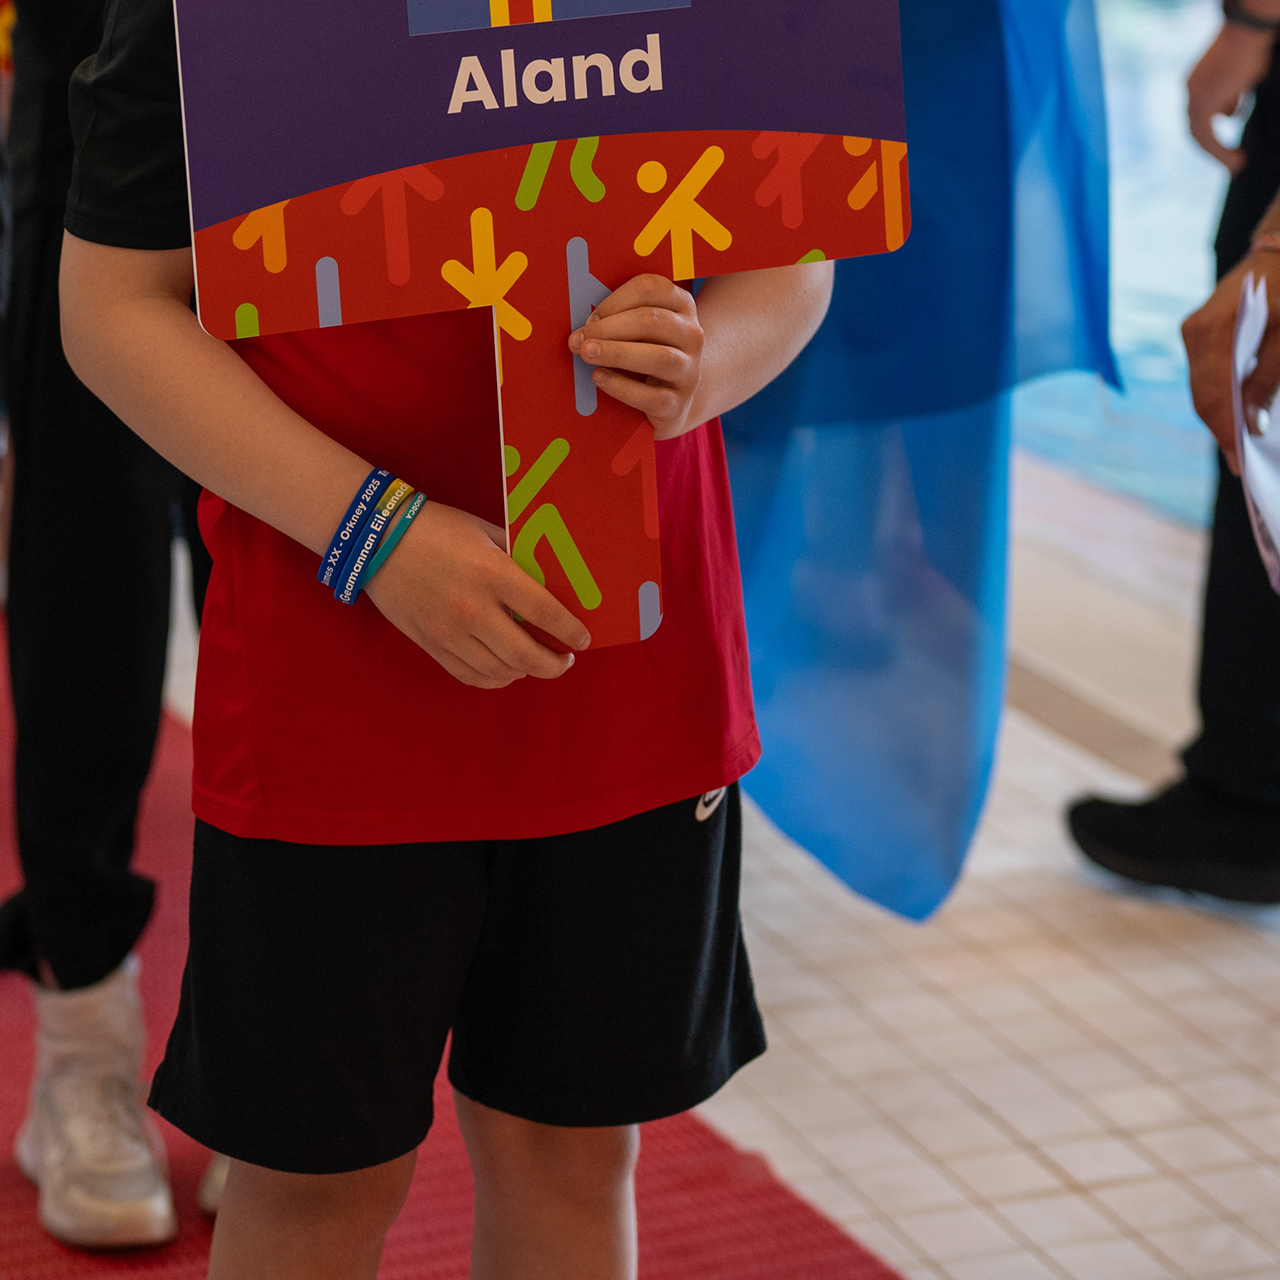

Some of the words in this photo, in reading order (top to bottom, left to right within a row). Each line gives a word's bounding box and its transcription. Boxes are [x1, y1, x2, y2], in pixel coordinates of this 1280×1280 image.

[447, 32, 663, 115] Aland
[327, 547, 342, 566] XX
[340, 501, 367, 541] Orkney
[361, 478, 381, 503] 2025
[339, 534, 378, 602] Geamannan
